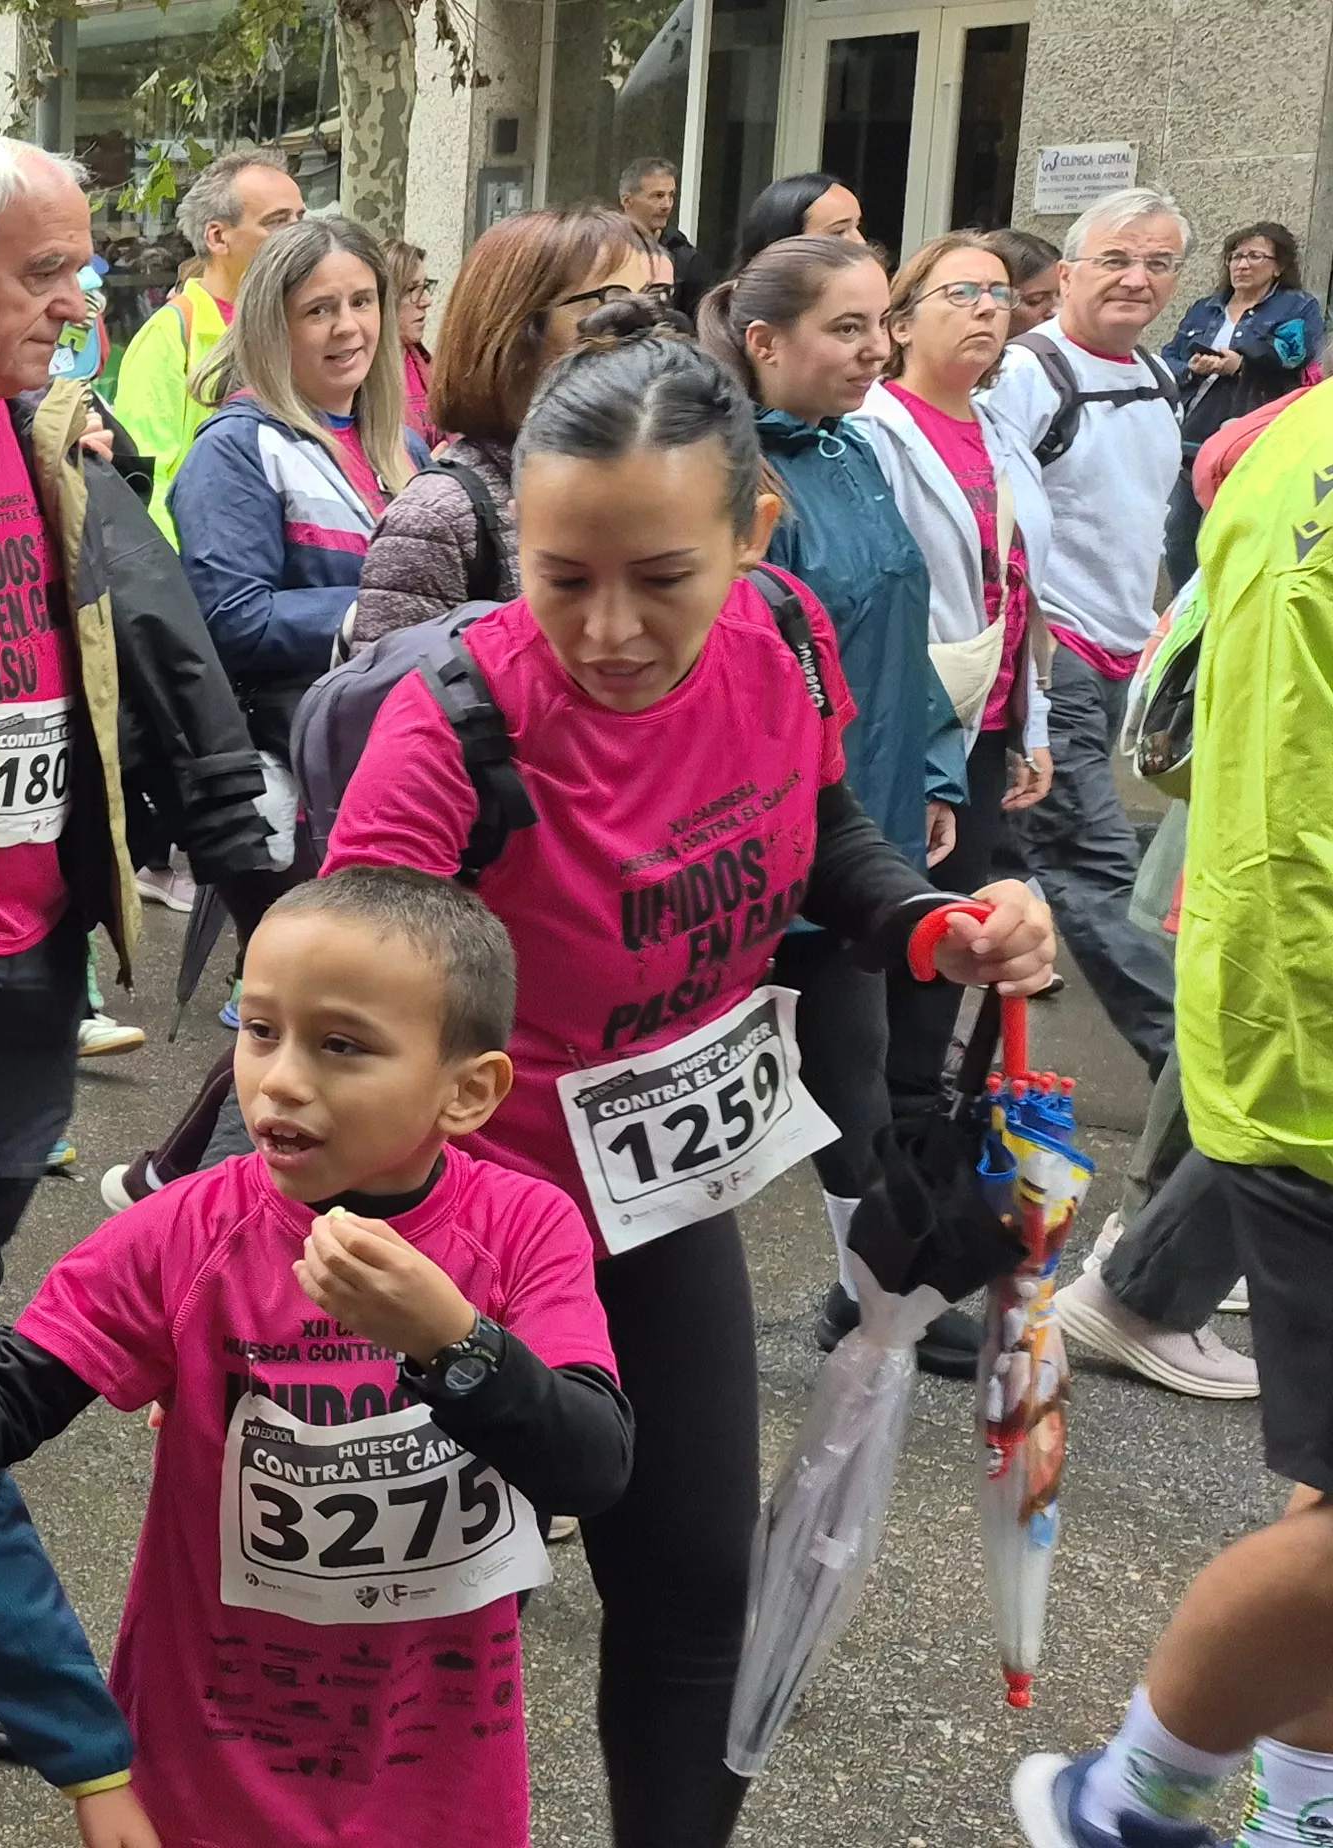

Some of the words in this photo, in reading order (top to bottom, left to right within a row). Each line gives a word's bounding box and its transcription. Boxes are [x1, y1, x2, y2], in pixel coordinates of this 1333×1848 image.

[1097, 151, 1131, 165] DENTAL
[620, 838, 769, 951] UNIDOS
[688, 916, 733, 972] EN
[671, 1043, 727, 1079] HUESCA
[598, 1081, 693, 1118] CONTRA
[694, 1066, 718, 1088] EL
[607, 1052, 780, 1185] 1259
[300, 1319, 329, 1339] XII
[224, 1335, 302, 1362] HUESCA
[338, 1434, 420, 1460] HUESCA
[252, 1448, 361, 1485] CONTRA
[367, 1458, 401, 1478] EL
[249, 1465, 501, 1569] 3275
